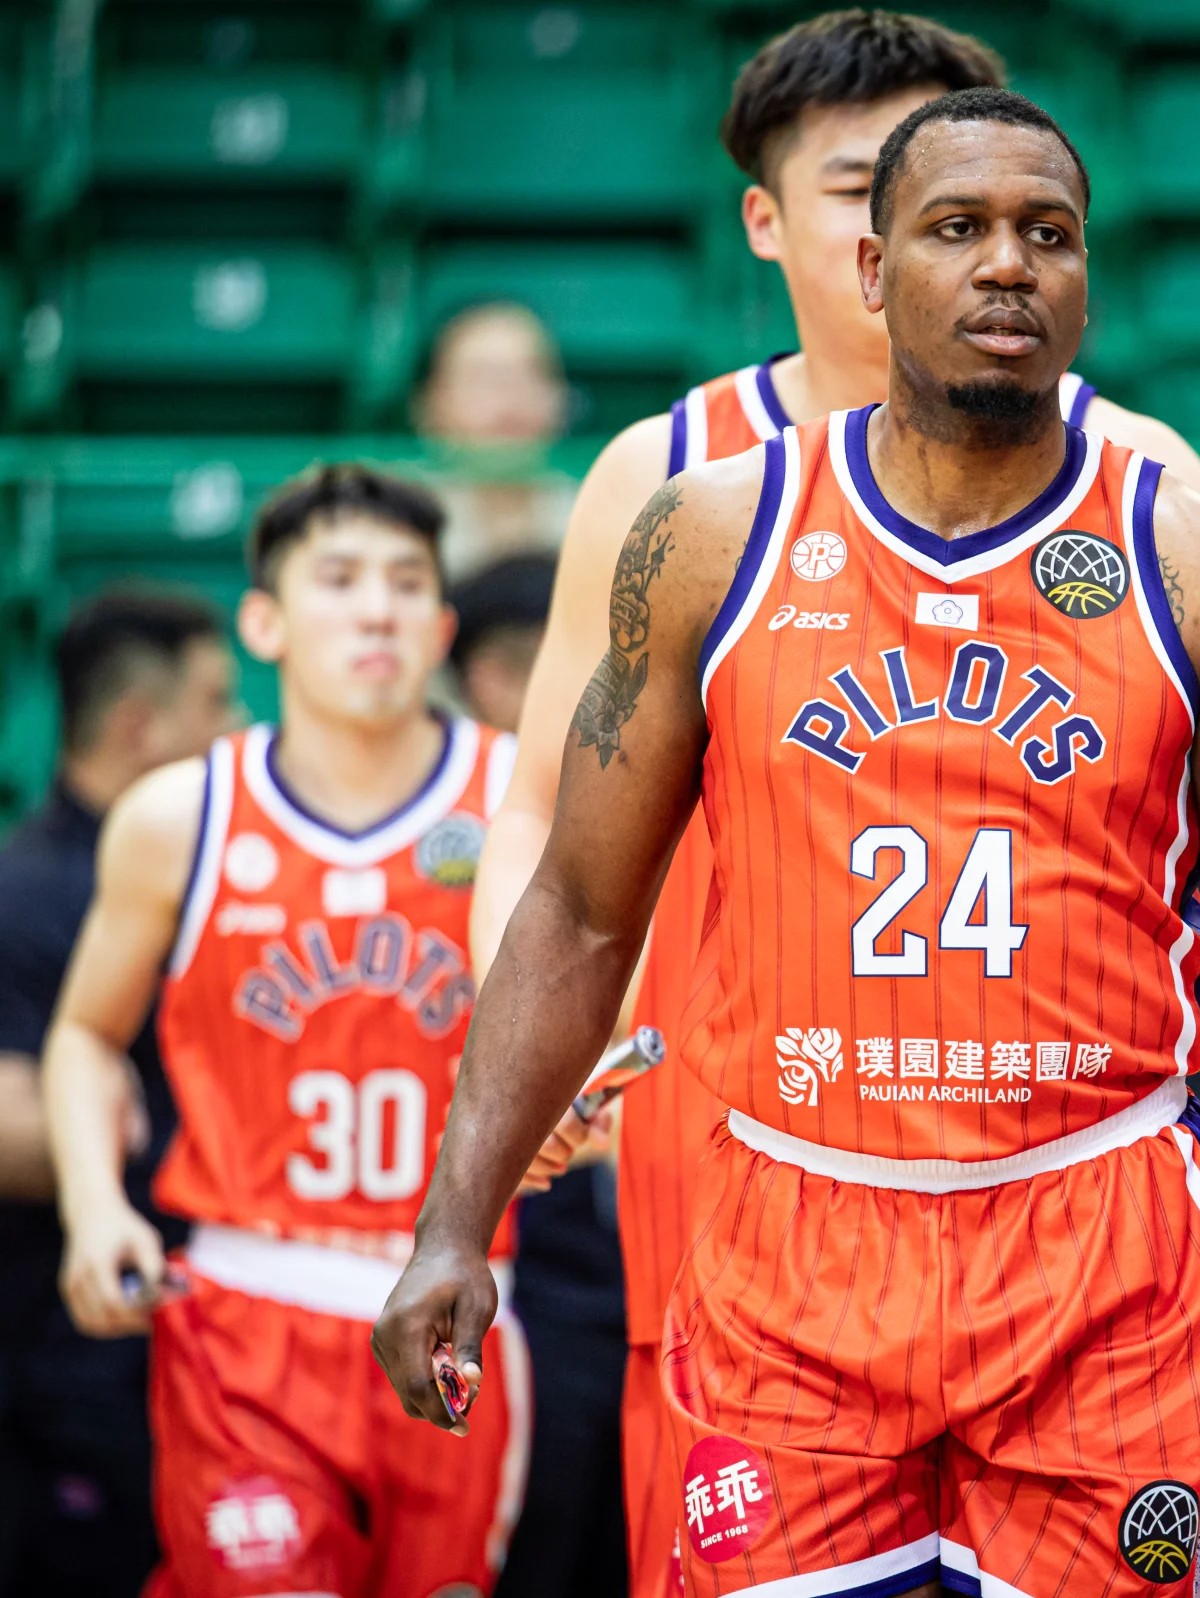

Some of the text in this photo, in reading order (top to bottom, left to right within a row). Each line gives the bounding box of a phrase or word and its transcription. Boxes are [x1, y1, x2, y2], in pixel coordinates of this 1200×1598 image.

[793, 611, 851, 630] asics
[780, 639, 1107, 786] PILOTS
[849, 825, 1030, 979] 24
[233, 911, 476, 1043] PILOTS
[855, 1037, 1113, 1082] 璞園建築團隊
[859, 1084, 1033, 1104] PAUIAN ARCHILAND
[285, 1068, 428, 1201] 30
[685, 1459, 764, 1535] 乖乖
[700, 1524, 749, 1549] SINCE 1968
